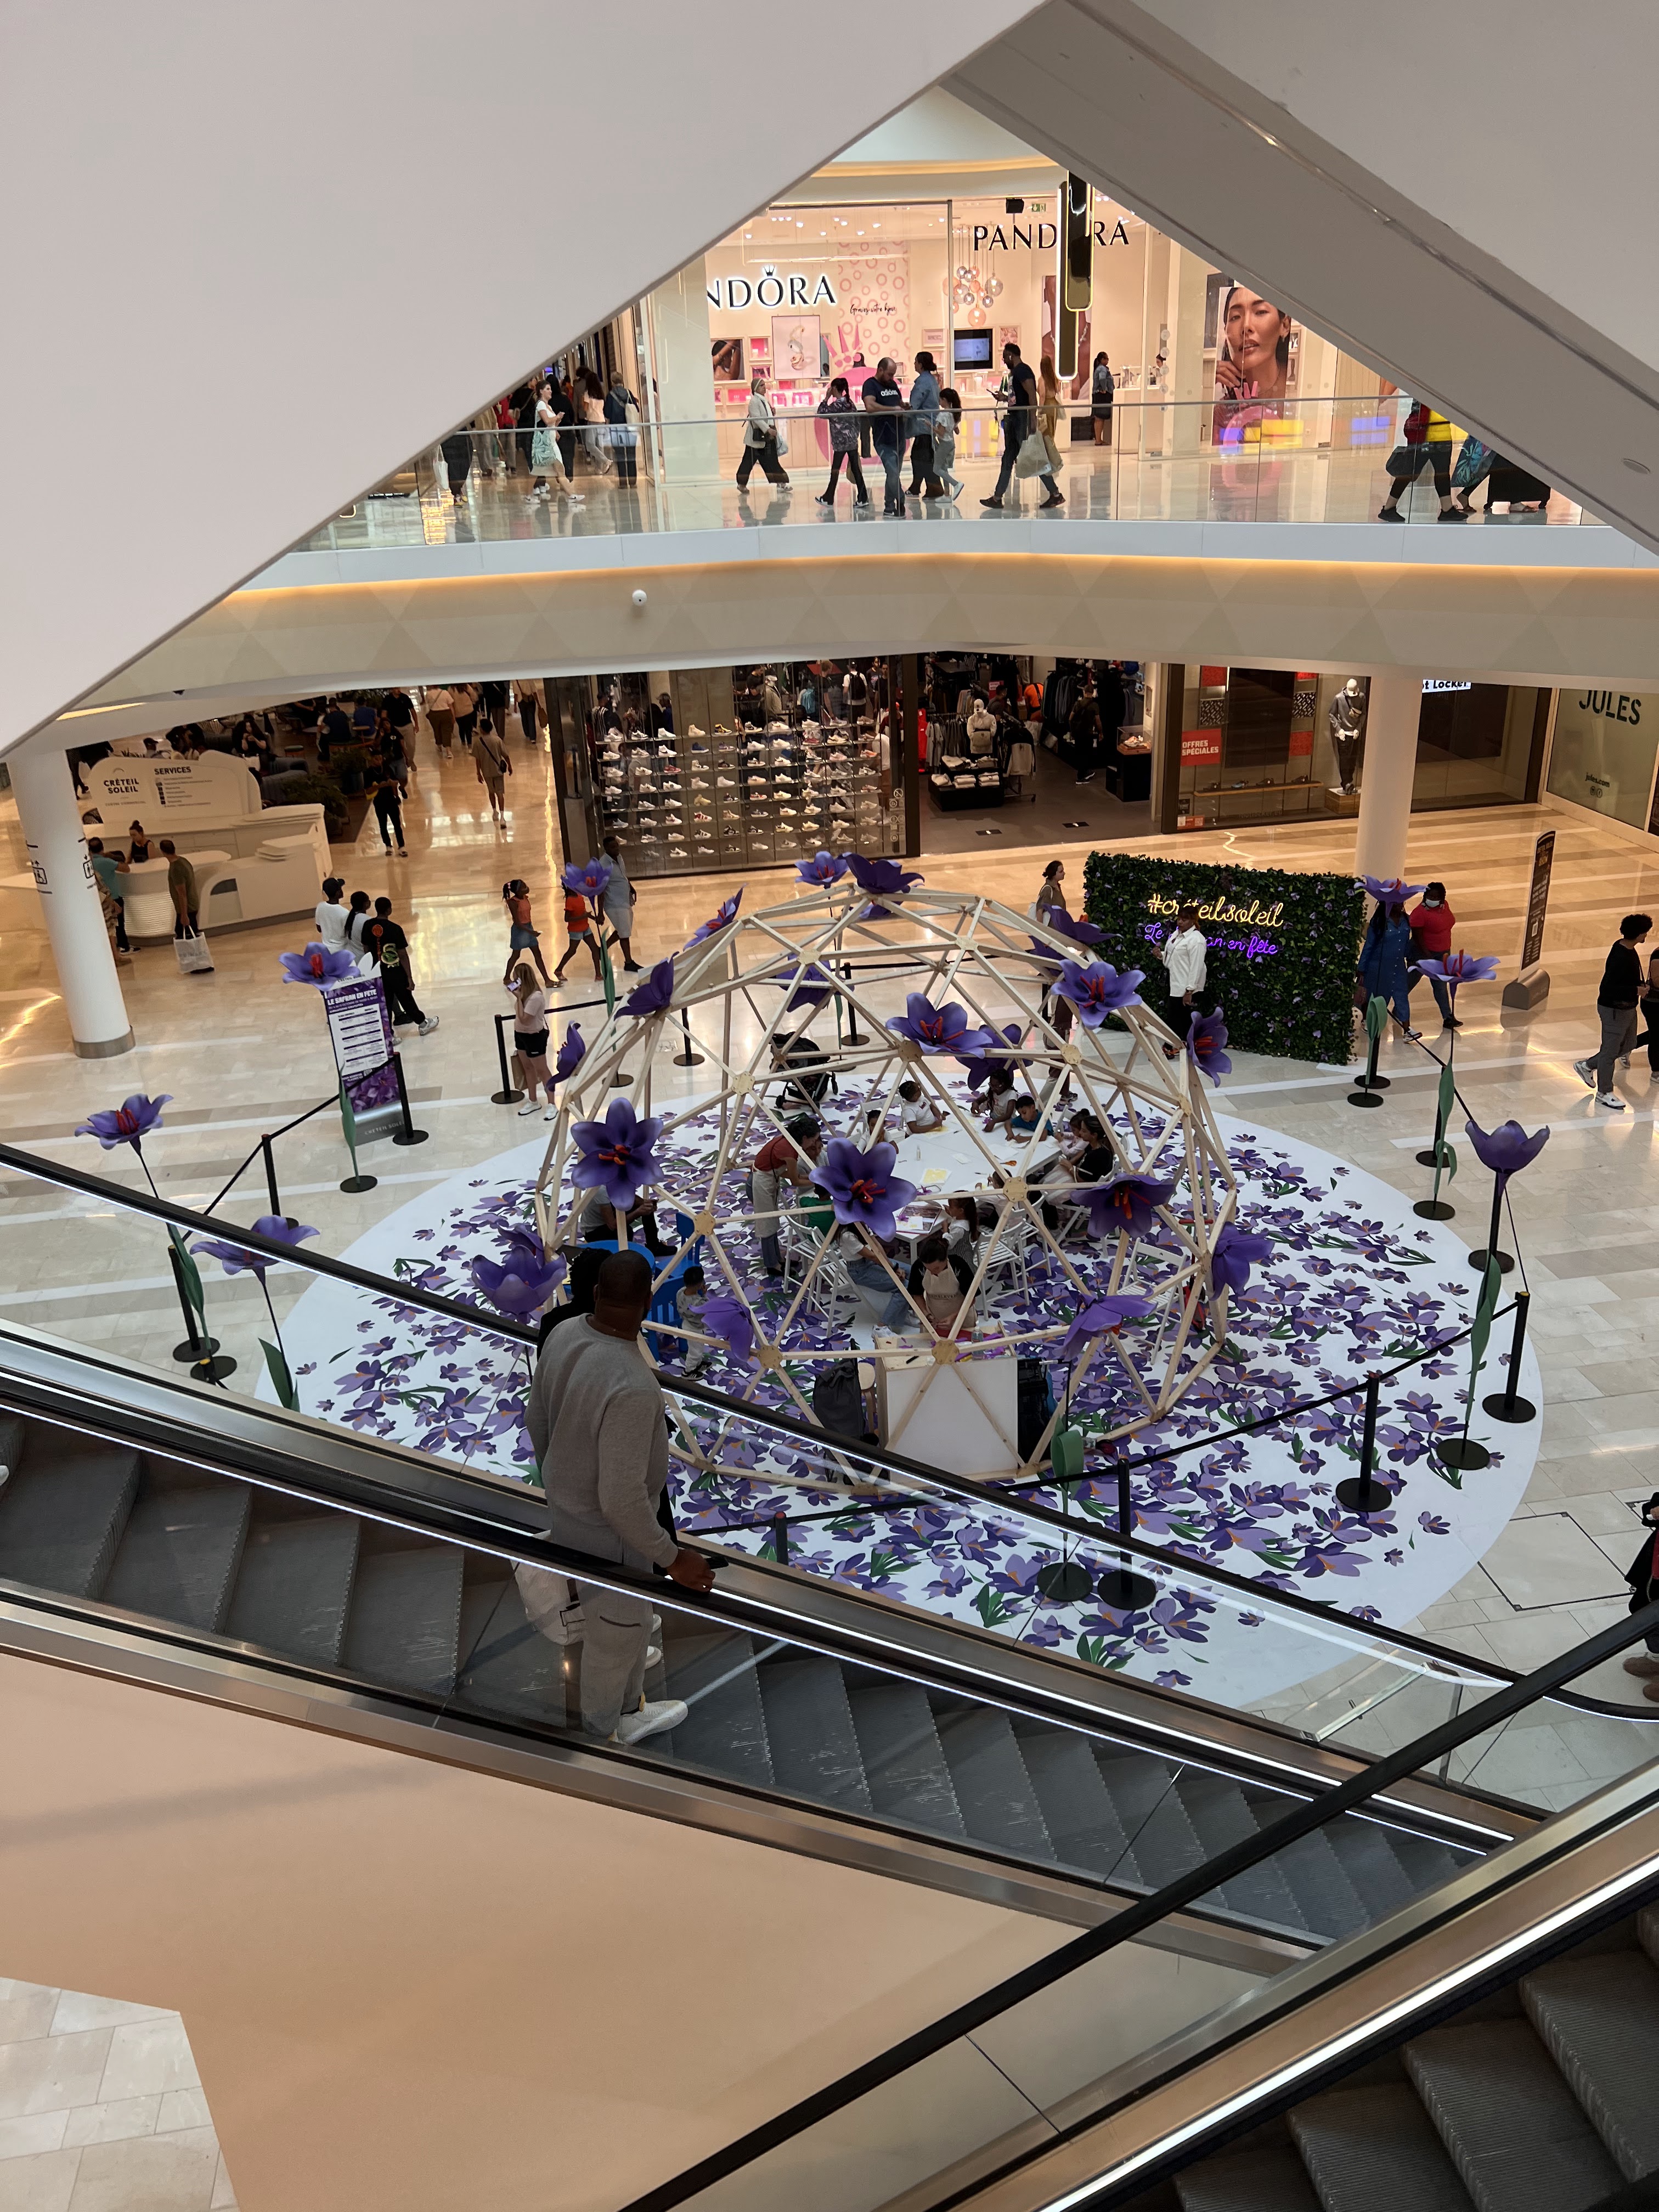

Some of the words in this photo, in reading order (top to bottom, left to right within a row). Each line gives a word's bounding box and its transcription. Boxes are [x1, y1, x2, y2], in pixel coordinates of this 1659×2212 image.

[974, 221, 1129, 251] PANDRA
[1579, 690, 1641, 725] JULES
[1182, 740, 1209, 748] OFFRES
[1182, 746, 1219, 756] SPÉCIALES
[154, 766, 191, 775] SERVICES
[1585, 772, 1610, 788] jules.com
[108, 786, 138, 794] SOLEIL
[1148, 893, 1284, 928] #creilsoleil
[1144, 922, 1163, 945] Le
[1228, 940, 1245, 951] en
[1246, 936, 1278, 959] fête
